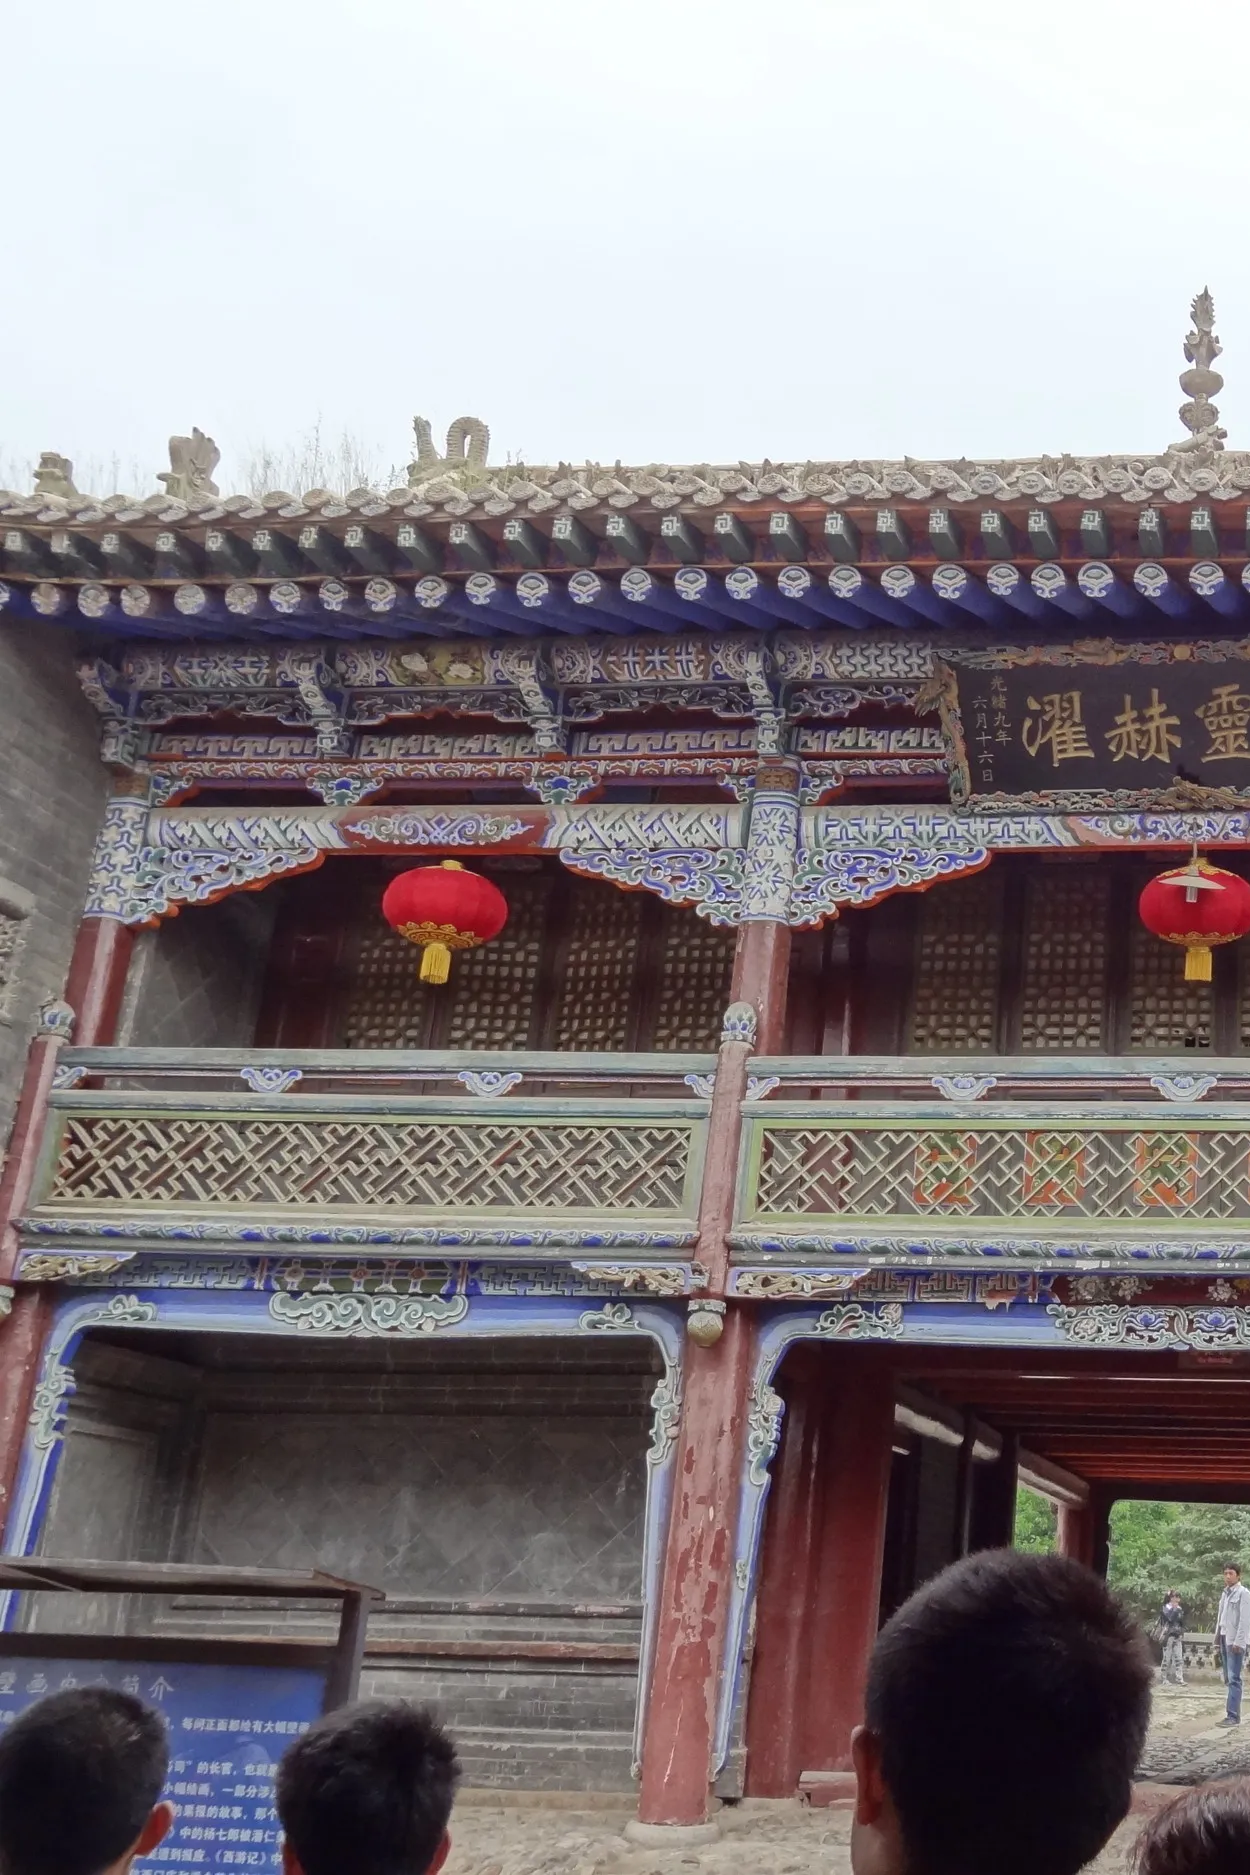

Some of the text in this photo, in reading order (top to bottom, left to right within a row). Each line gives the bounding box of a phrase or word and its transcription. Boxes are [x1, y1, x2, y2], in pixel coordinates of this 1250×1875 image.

[972, 696, 995, 782] 六月十六日
